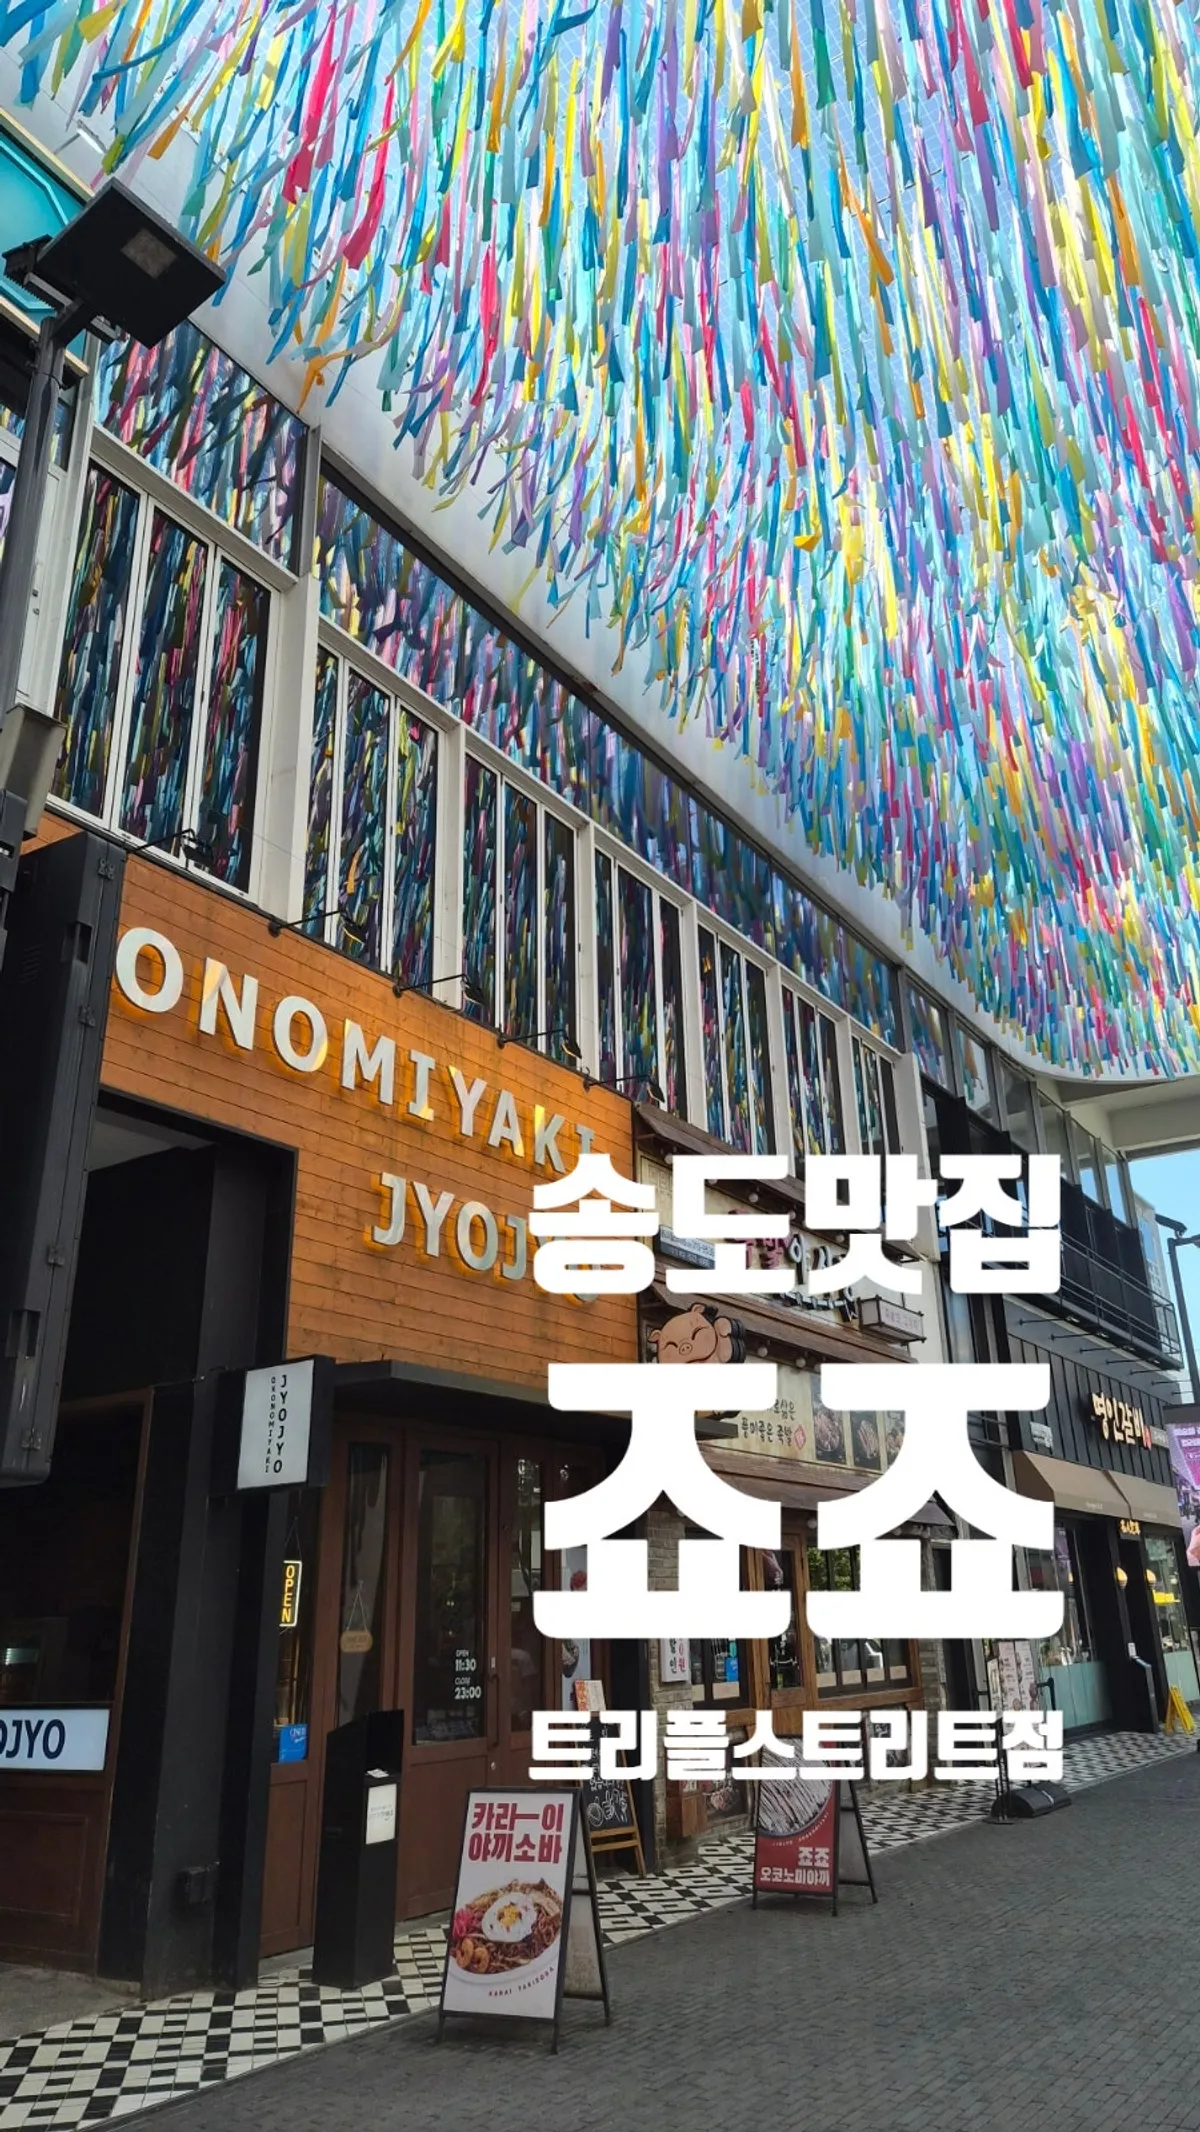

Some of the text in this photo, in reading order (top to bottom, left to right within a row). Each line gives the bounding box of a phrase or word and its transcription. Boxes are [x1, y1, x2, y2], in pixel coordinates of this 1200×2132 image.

[273, 1374, 287, 1474] JYOJYO
[1092, 1392, 1144, 1445] 명인갈비
[281, 1564, 295, 1623] OPEN
[455, 1658, 477, 1672] 11:30
[454, 1685, 482, 1700] 23:00
[467, 1832, 563, 1864] 야끼소바
[797, 1846, 830, 1868] 죠죠
[760, 1866, 831, 1887] 오코노미야끼
